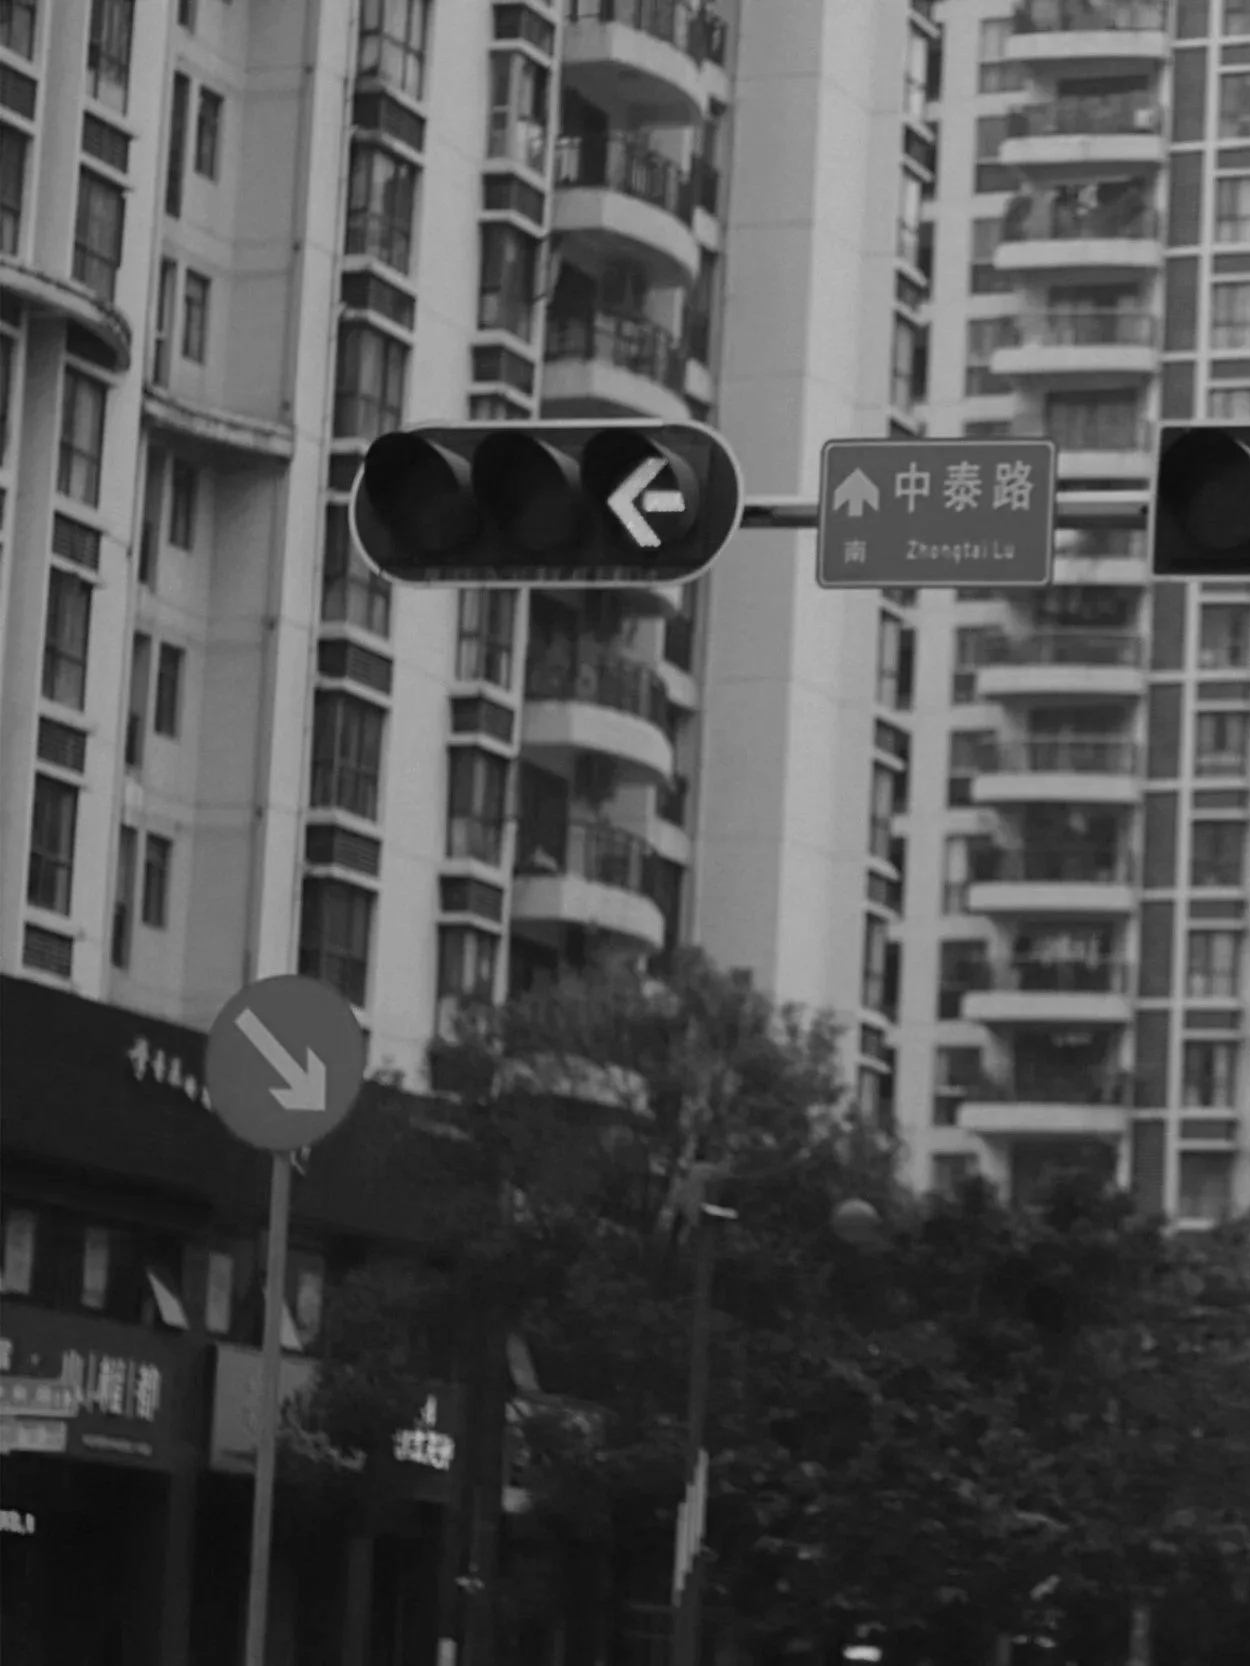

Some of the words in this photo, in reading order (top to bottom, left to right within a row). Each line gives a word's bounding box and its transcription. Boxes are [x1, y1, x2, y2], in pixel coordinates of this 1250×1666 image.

[895, 460, 1034, 513] 中泰路
[844, 538, 867, 563] 南
[905, 540, 988, 563] Zhongtai
[993, 540, 1015, 560] Lu
